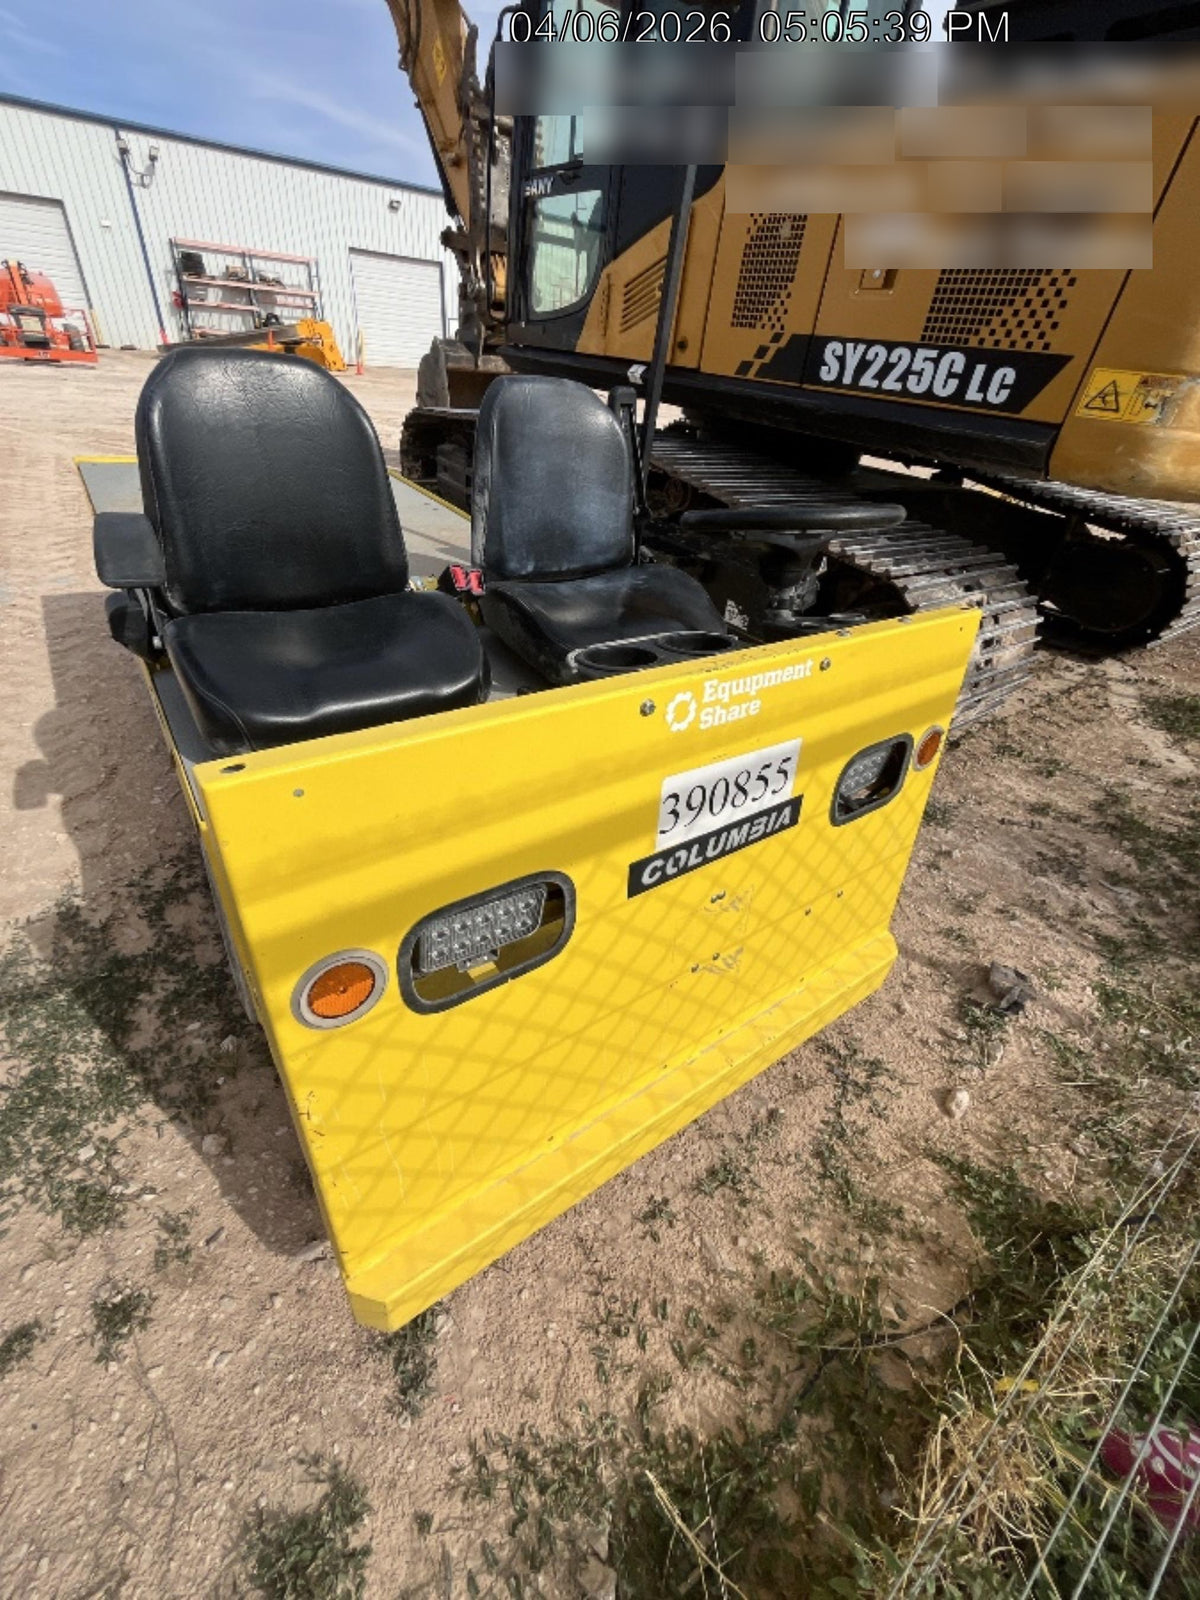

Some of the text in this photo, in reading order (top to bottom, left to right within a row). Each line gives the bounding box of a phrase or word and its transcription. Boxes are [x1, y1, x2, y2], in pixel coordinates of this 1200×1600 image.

[819, 341, 1017, 405] SY225C LC
[702, 658, 814, 704] Equipment
[699, 699, 762, 730] Share
[658, 756, 793, 835] 390855
[640, 805, 792, 887] COLUMBIA
